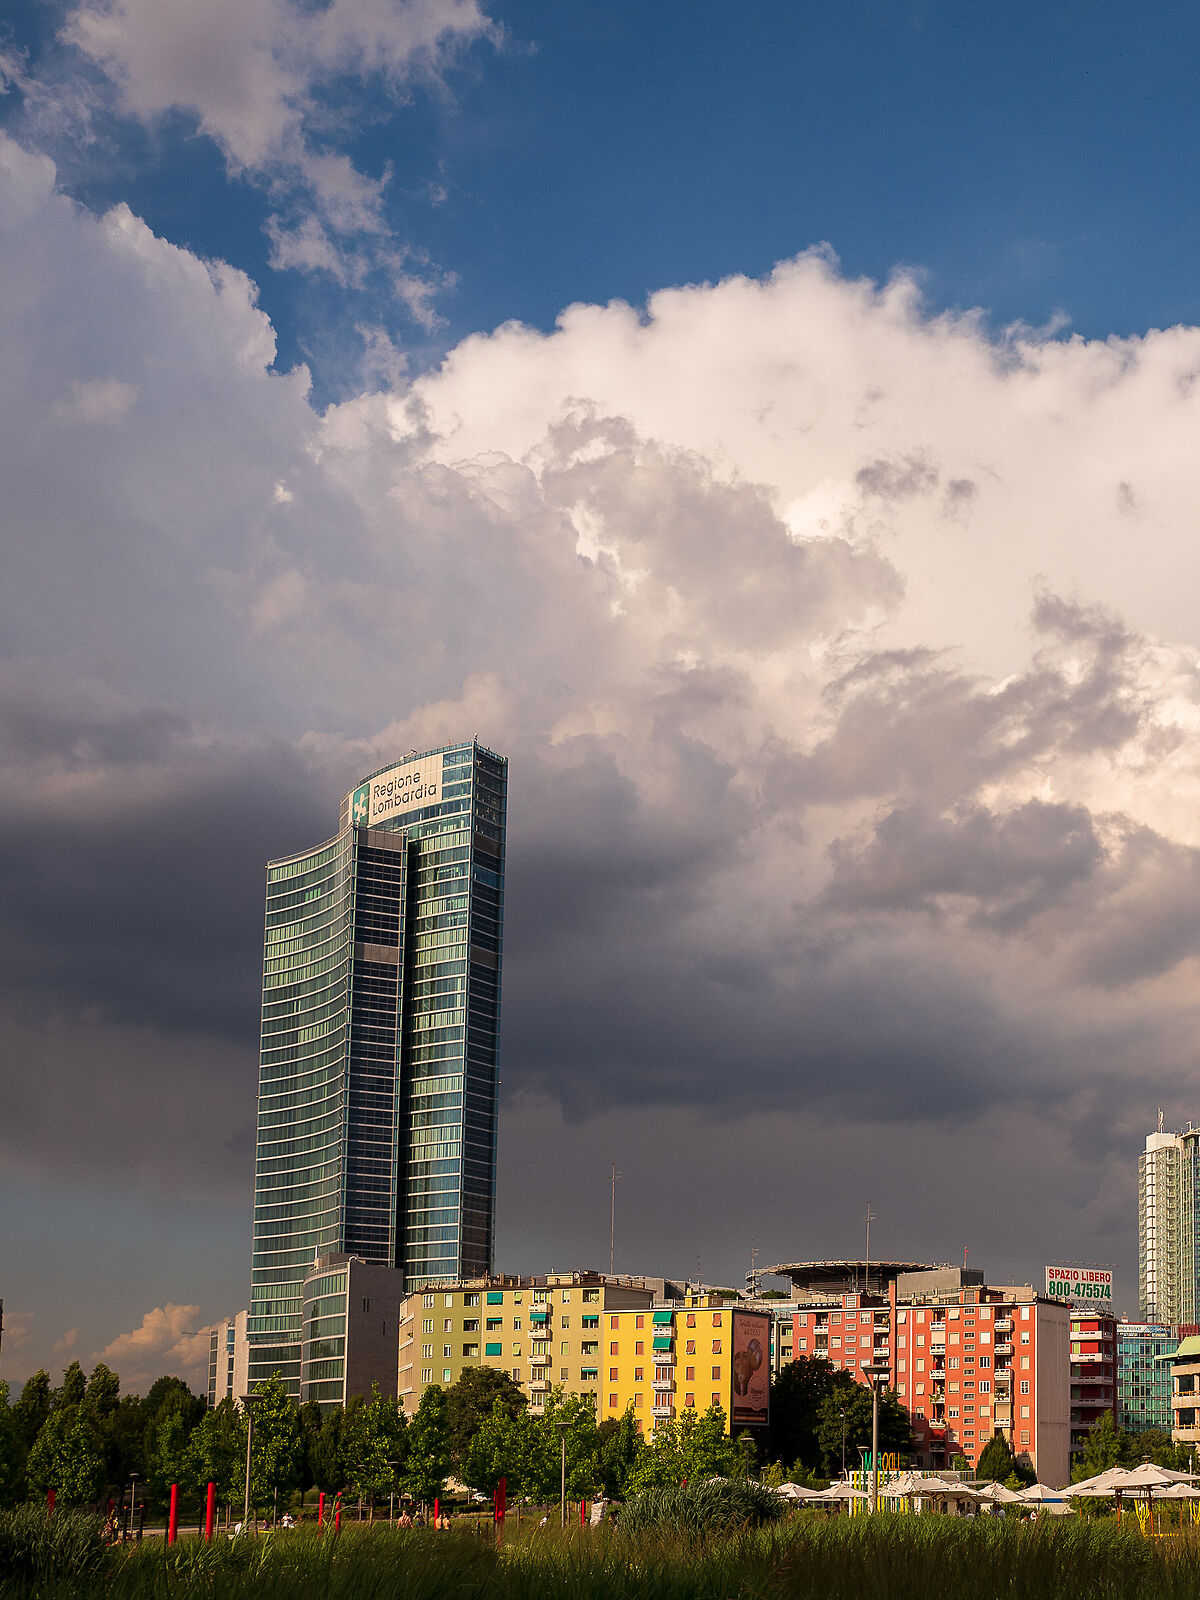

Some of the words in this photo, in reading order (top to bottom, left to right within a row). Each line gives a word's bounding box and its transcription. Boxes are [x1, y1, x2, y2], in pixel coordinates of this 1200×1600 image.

[373, 772, 420, 799] Regione
[373, 784, 436, 816] Lombardia
[1048, 1269, 1079, 1280] SPAZIO
[1082, 1271, 1111, 1282] LIBERO
[1049, 1281, 1111, 1299] 800-475574
